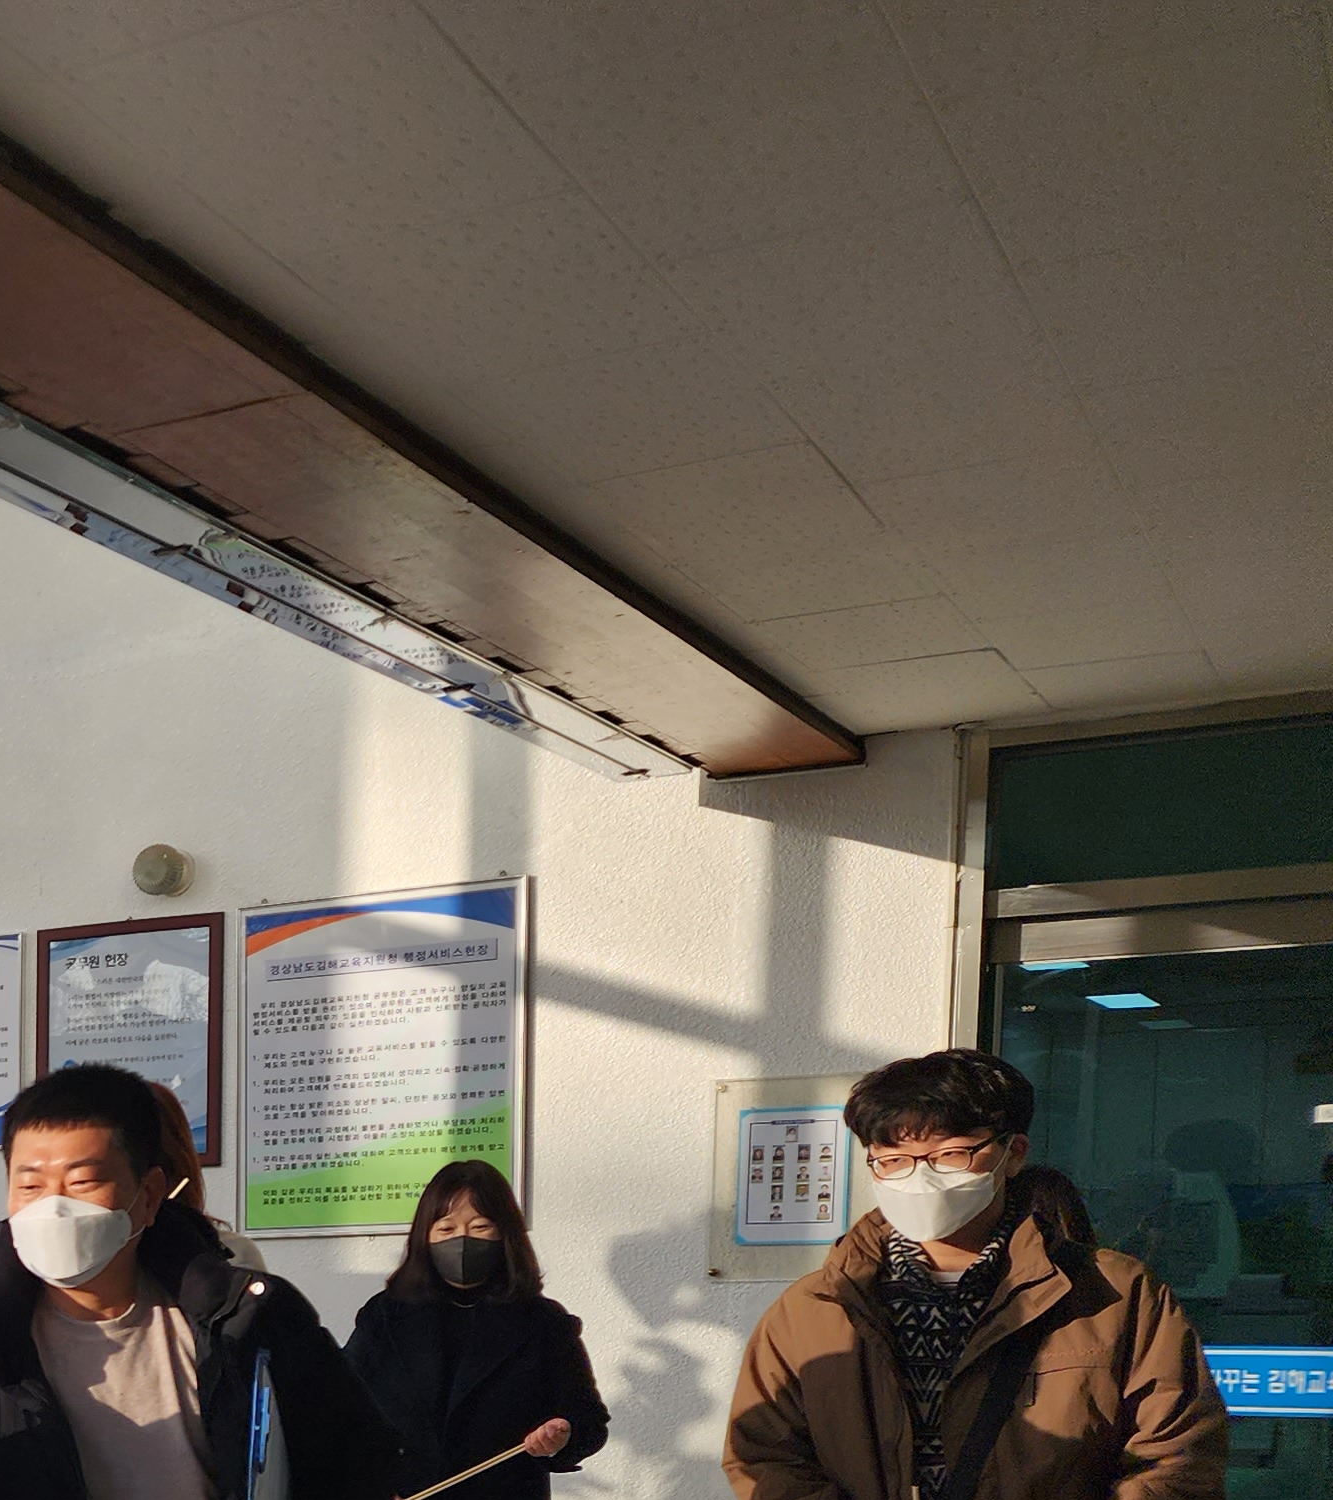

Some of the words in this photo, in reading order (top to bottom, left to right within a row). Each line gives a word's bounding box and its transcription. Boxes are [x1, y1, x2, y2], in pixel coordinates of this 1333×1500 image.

[105, 953, 129, 968] 헌장
[270, 952, 397, 976] 경상남도김해교육지원청
[403, 943, 488, 963] 행정서비스헌장
[1268, 1369, 1333, 1395] 김해교
